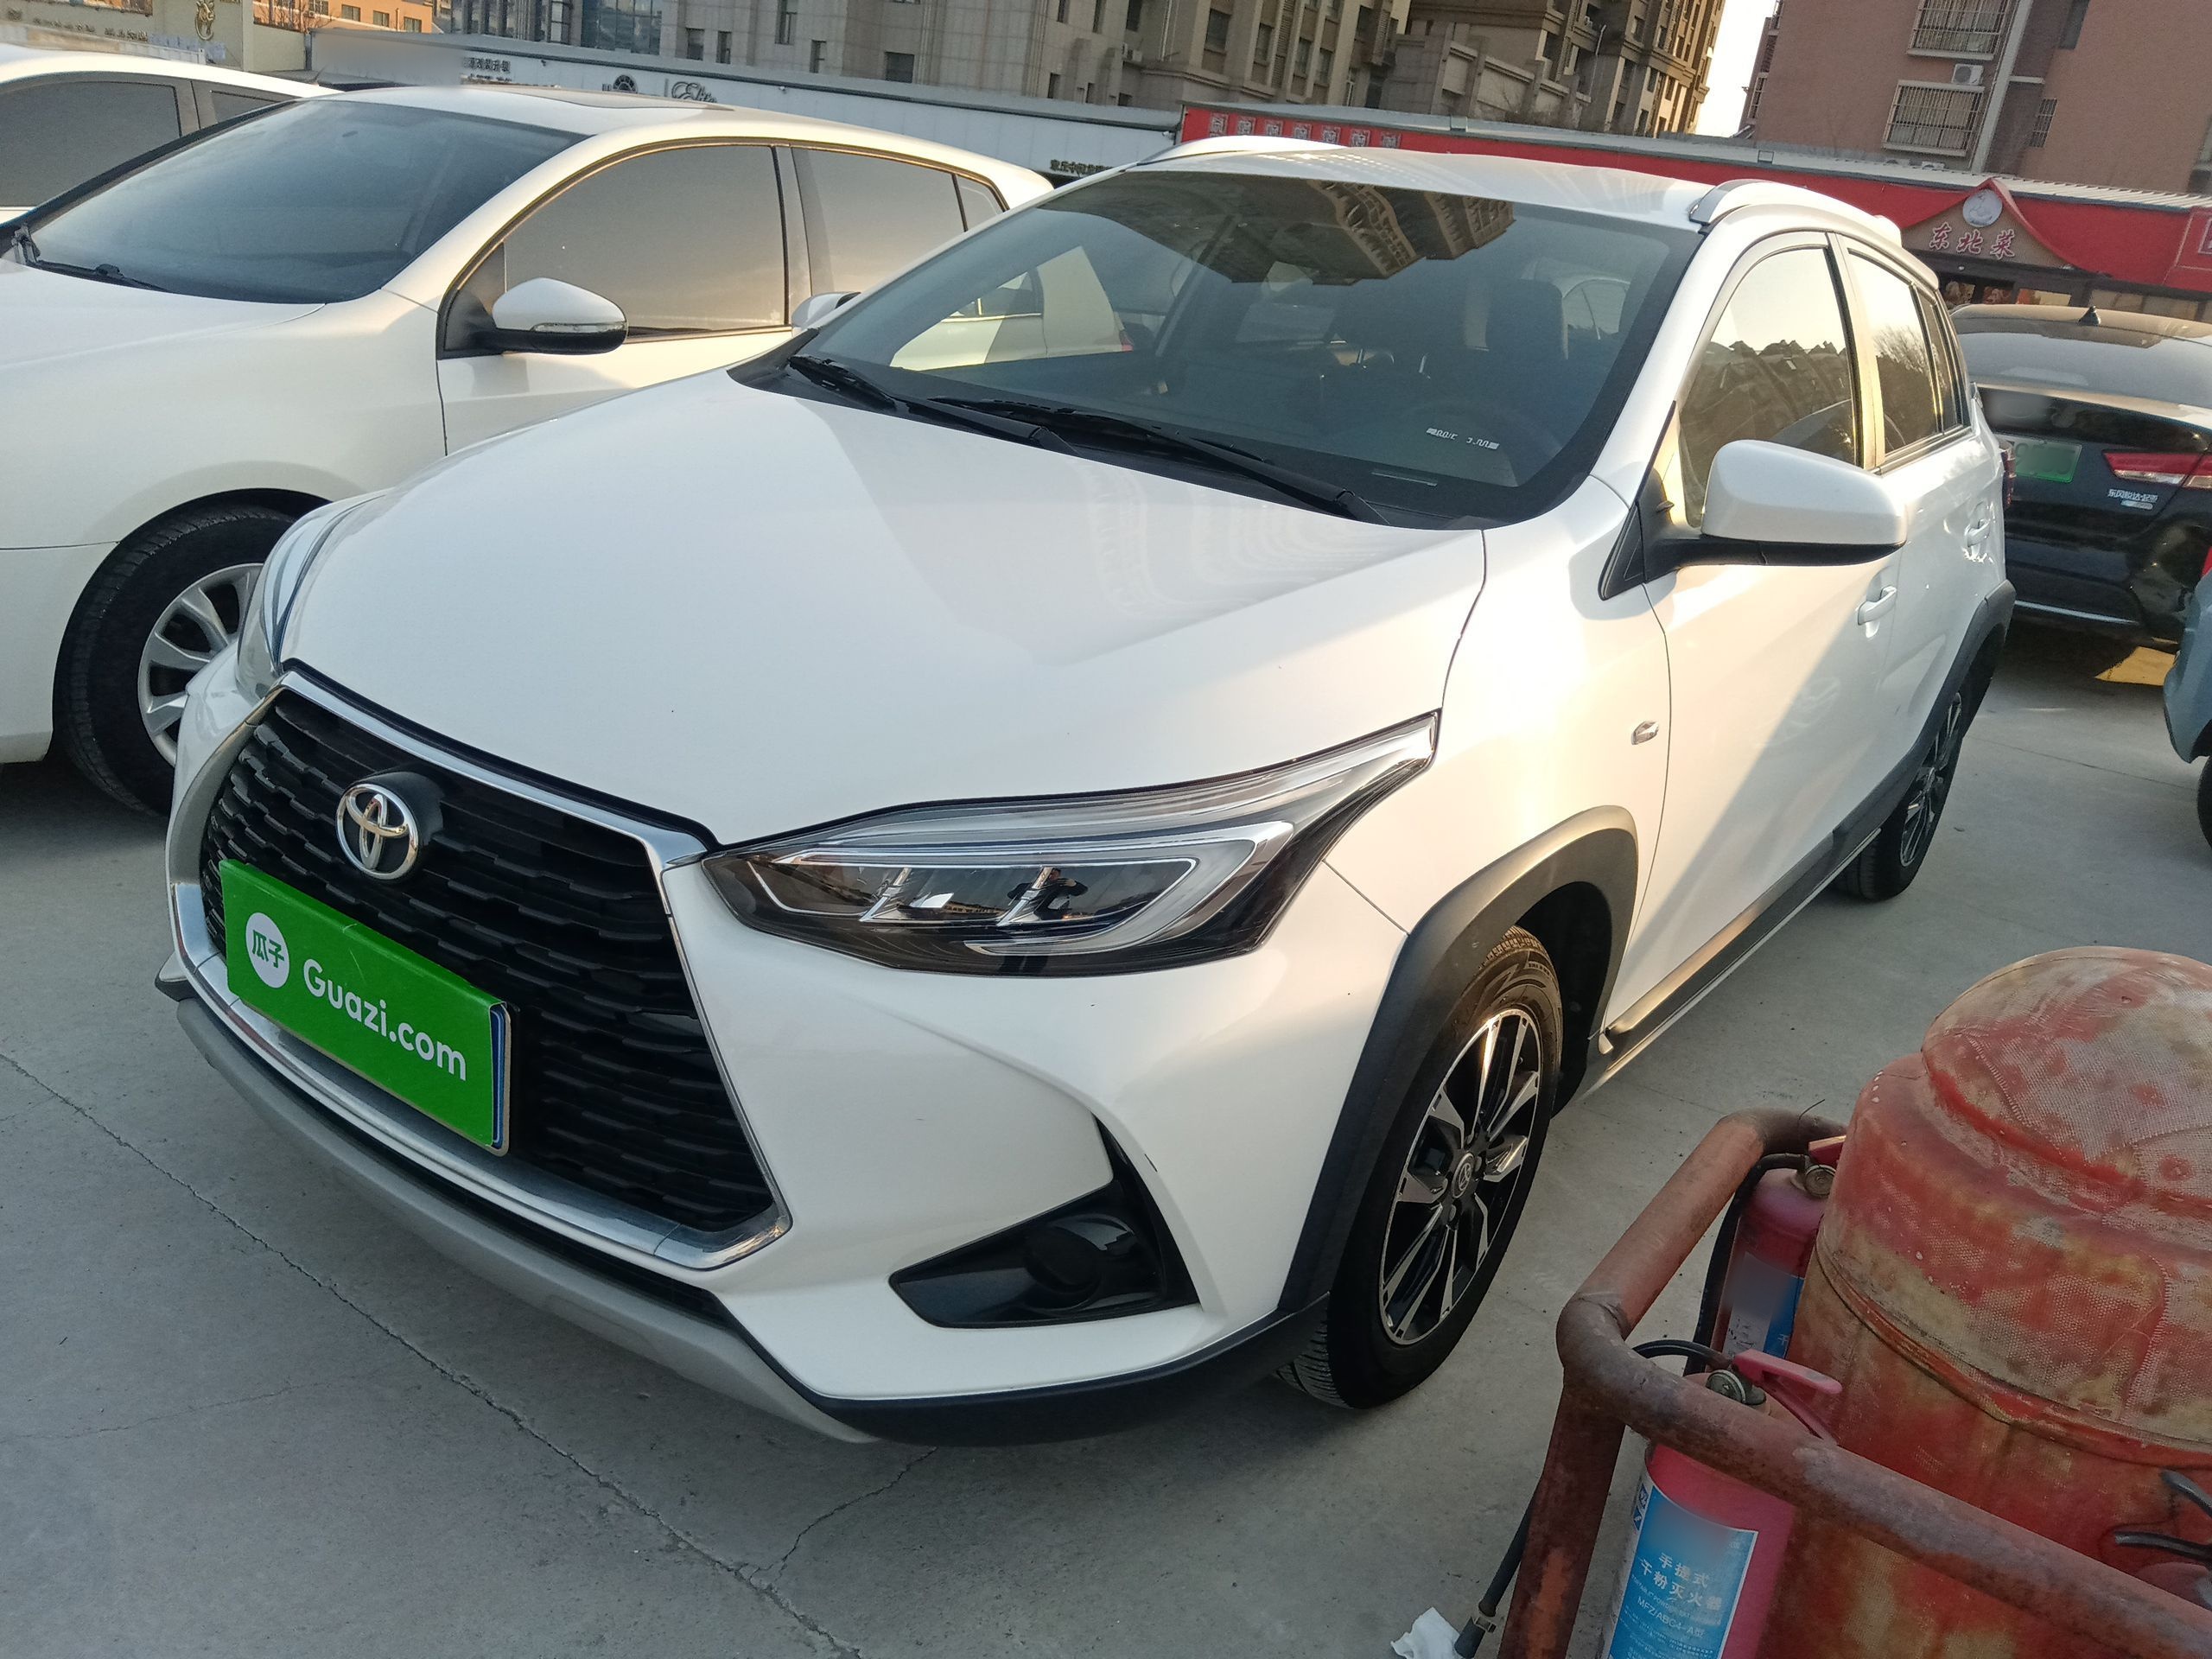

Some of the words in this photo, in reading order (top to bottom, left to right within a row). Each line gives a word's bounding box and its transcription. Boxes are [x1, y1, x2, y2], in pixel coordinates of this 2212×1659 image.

[1929, 222, 2015, 259] 东北菜
[252, 930, 285, 968] 瓜子
[304, 959, 466, 1081] Guazi.com
[1659, 1553, 1709, 1588] 手提式
